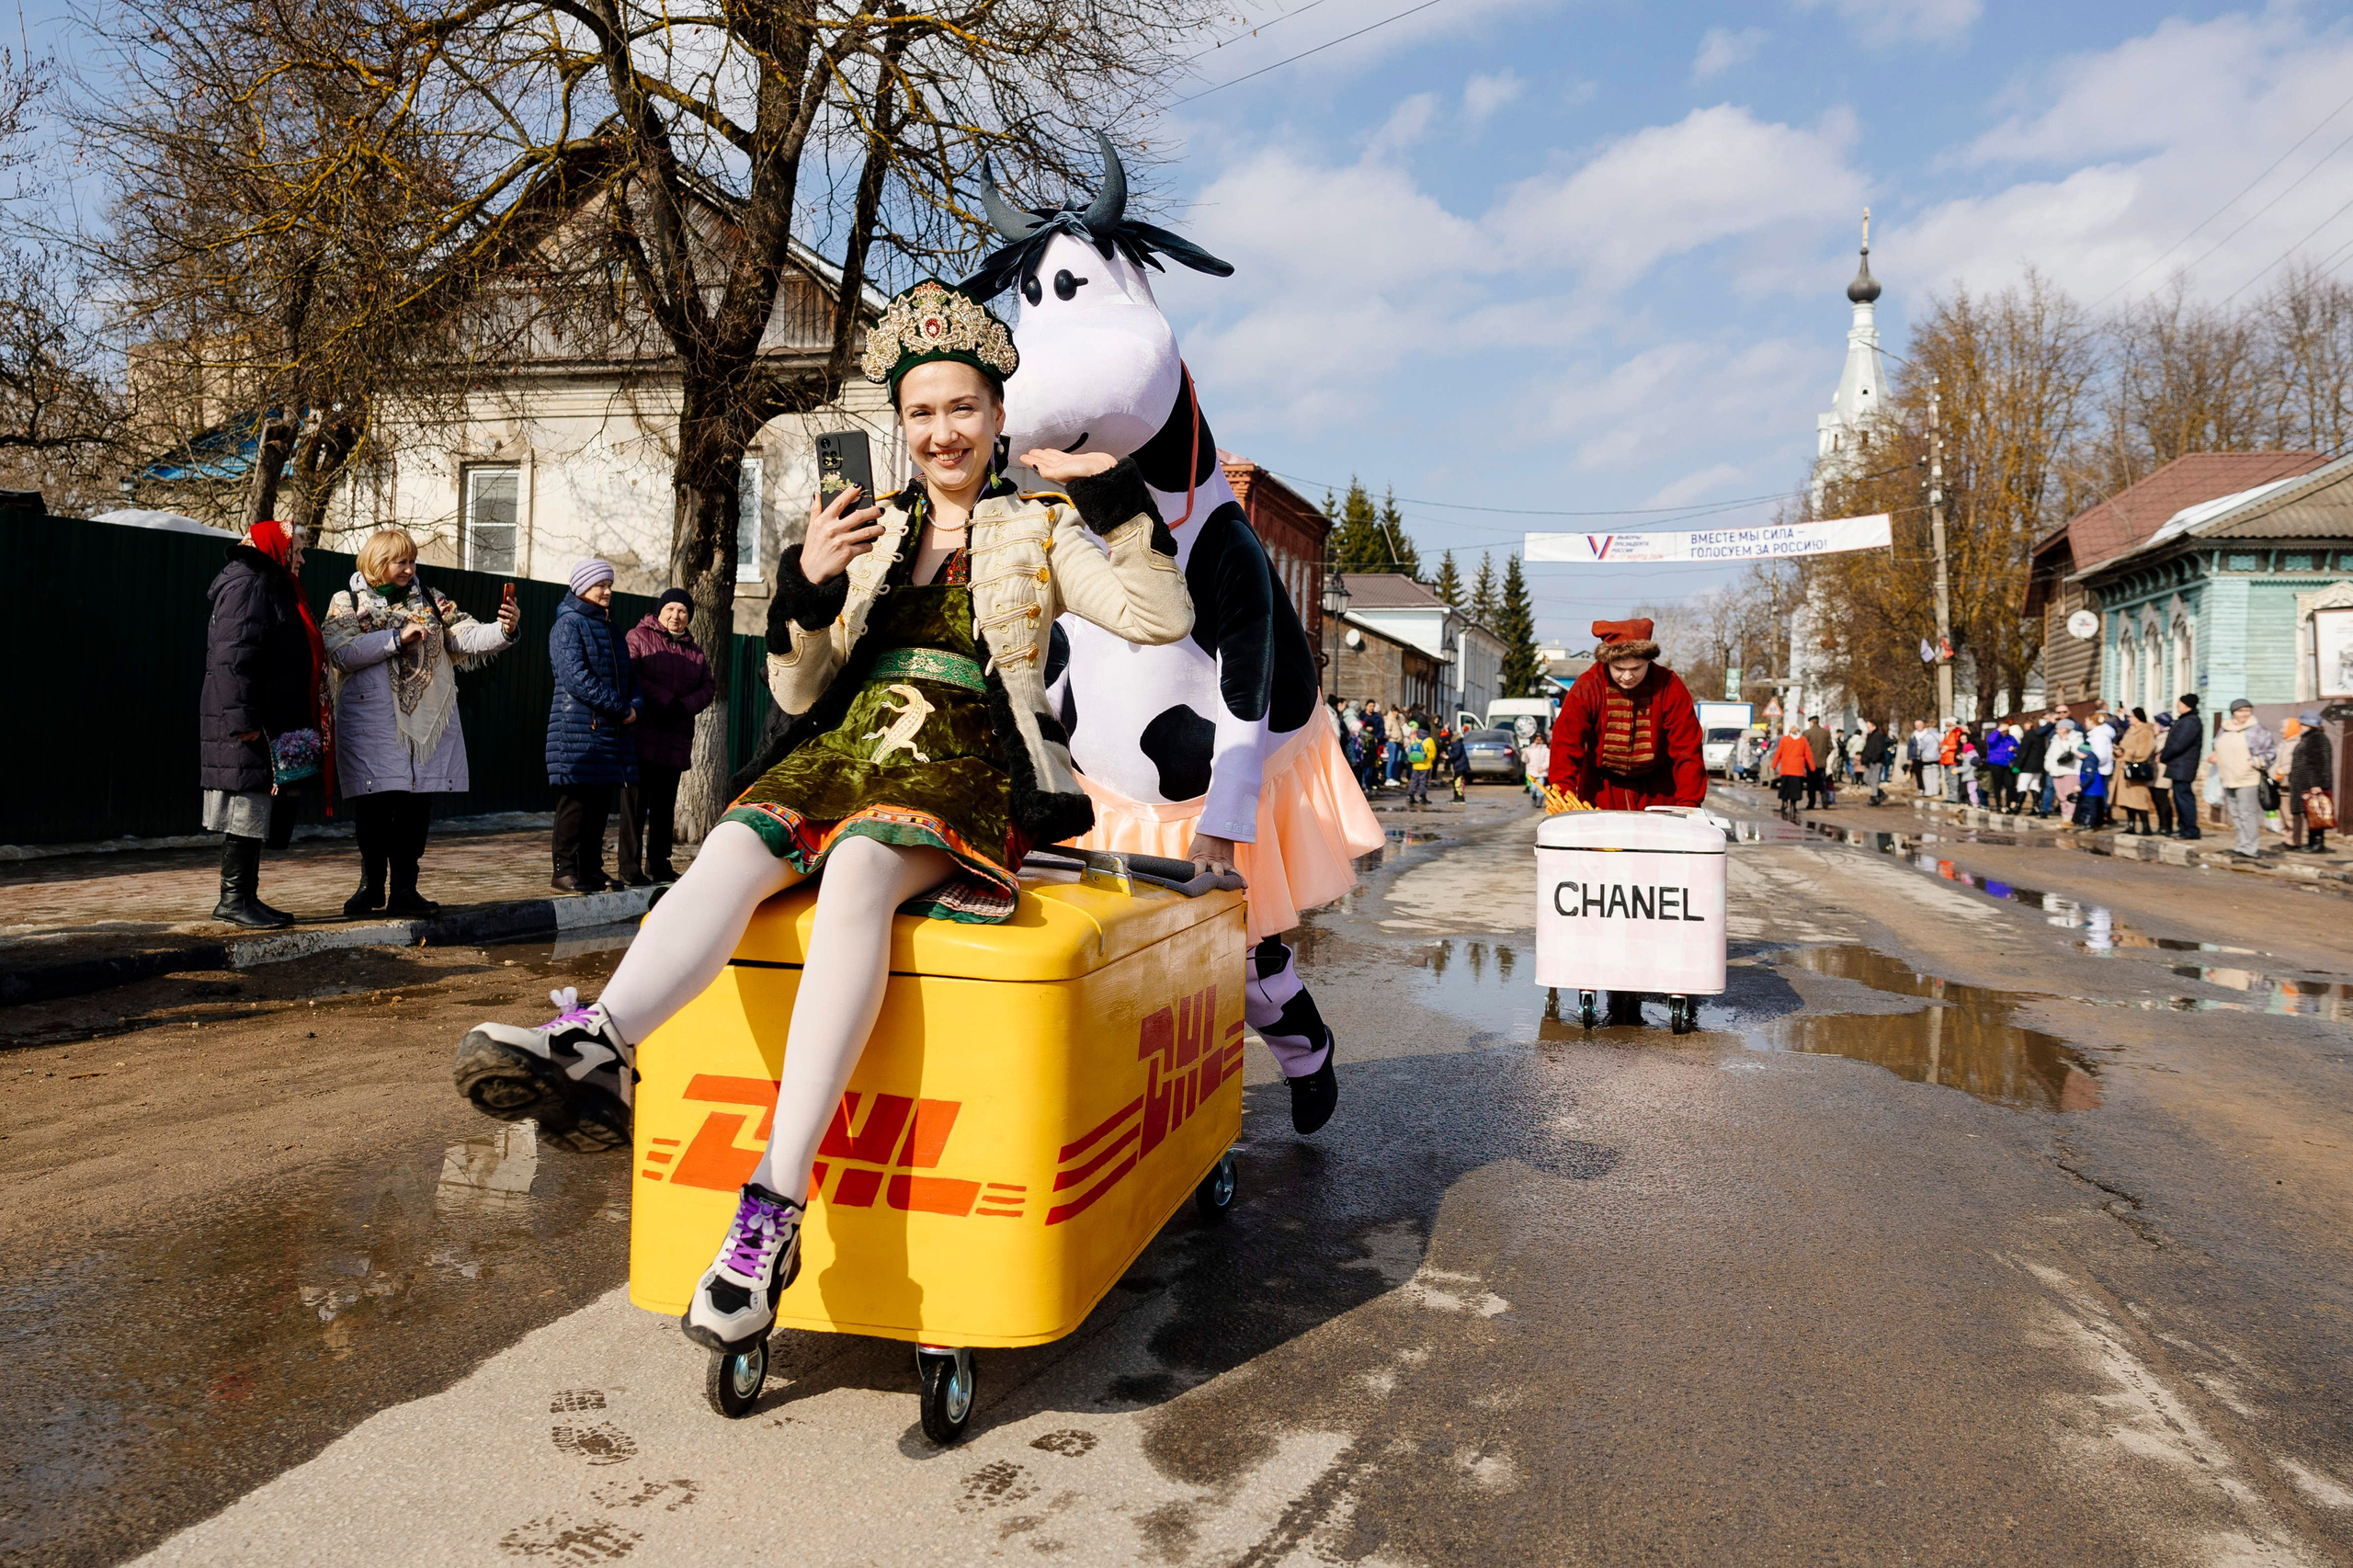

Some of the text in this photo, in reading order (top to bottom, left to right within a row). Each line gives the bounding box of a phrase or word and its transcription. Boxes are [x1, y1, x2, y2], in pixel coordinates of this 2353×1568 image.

[1691, 532, 1735, 544] ВМЕСТЕ
[1739, 531, 1759, 541] МЫ
[1763, 528, 1794, 540] СИЛА
[1691, 539, 1827, 558] ГОЛОСУЕМ ЗА РОССИЮ!
[1553, 881, 1705, 922] CHANEL
[1137, 983, 1224, 1162] DHL
